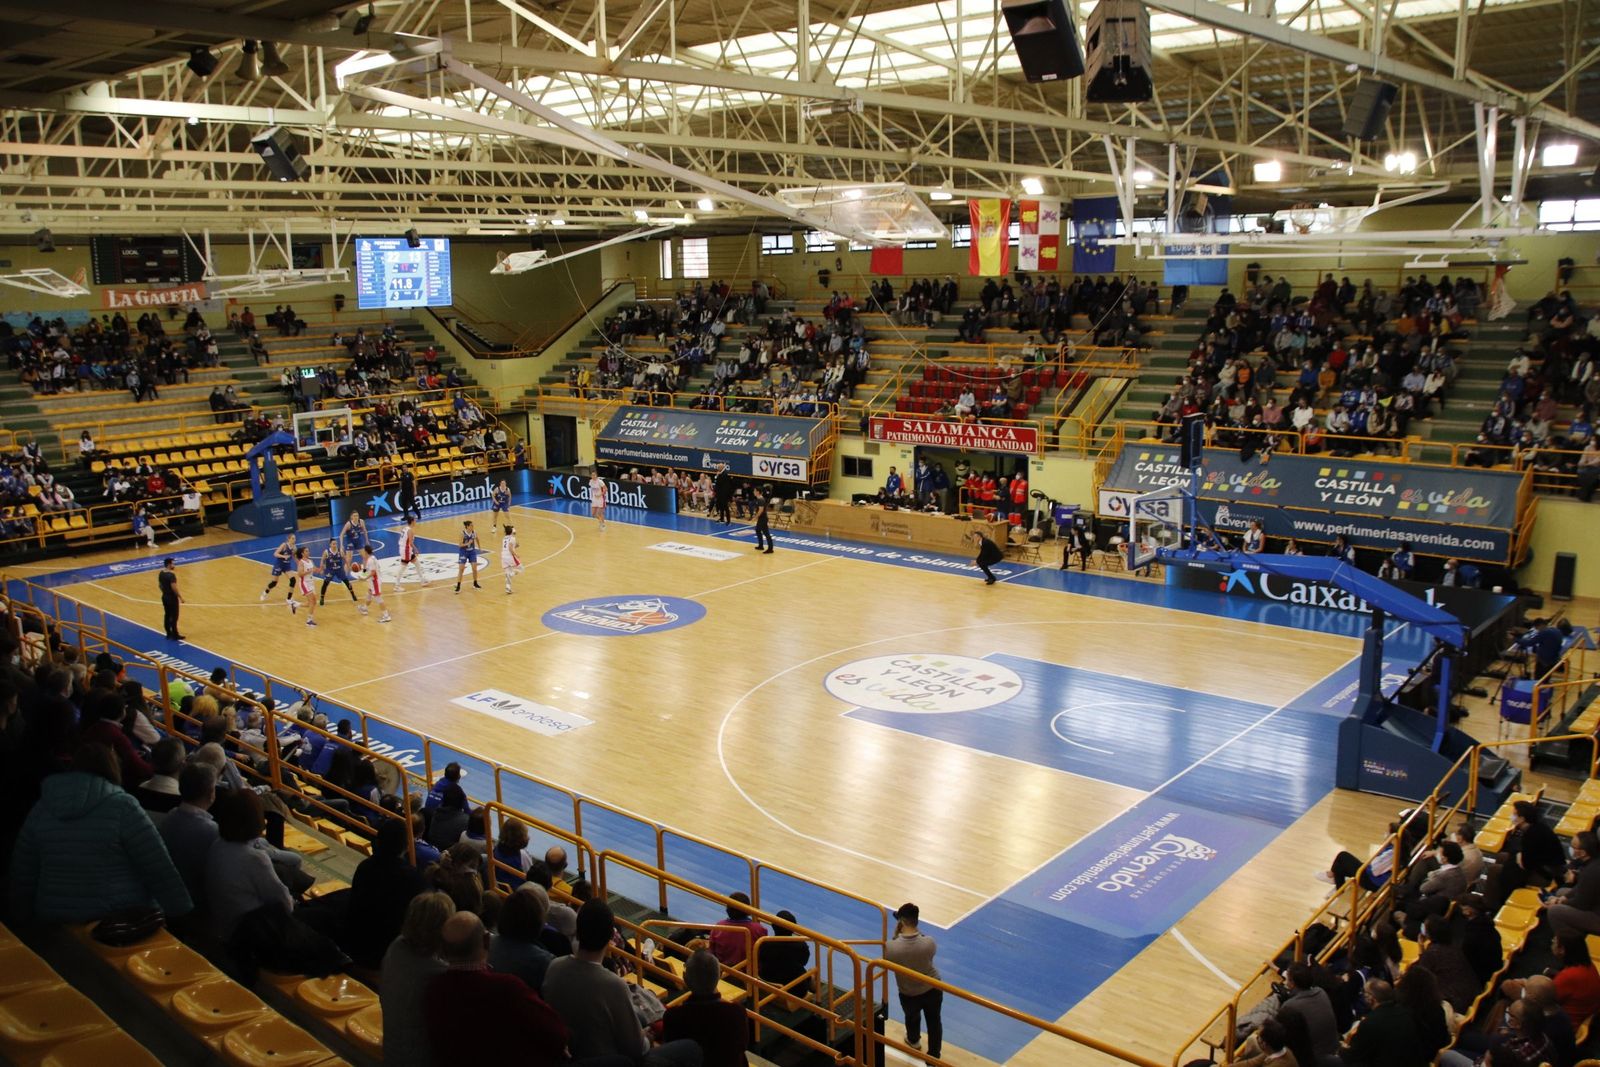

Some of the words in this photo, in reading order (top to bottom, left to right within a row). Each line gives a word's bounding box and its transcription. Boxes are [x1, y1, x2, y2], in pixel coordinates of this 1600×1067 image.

[391, 278, 413, 289] 11.8
[108, 289, 133, 308] LA
[134, 287, 201, 305] GACETA
[620, 419, 658, 428] CASTILLA
[715, 427, 759, 437] CASTILLA
[903, 421, 1017, 440] SALAMANCA
[625, 428, 649, 437] LEÓN
[886, 430, 946, 444] PATRIMONIO
[945, 435, 957, 445] DE
[960, 437, 971, 447] LA
[973, 438, 1033, 451] HUMANIDAD
[721, 437, 749, 446] LEÓN
[600, 446, 688, 463] www.perfumeriasavenida.com
[1138, 474, 1149, 483] Y
[1149, 475, 1191, 488] LEÓN
[1229, 470, 1282, 490] vida
[1314, 478, 1396, 495] CASTILLA
[1428, 487, 1491, 509] vida
[1320, 492, 1332, 503] Y
[1333, 492, 1383, 508] LEÓN
[1293, 518, 1495, 551] www.perfumeriasavenida.com
[875, 551, 902, 559] de
[560, 610, 646, 632] AVENIDA
[880, 668, 900, 676] Y
[897, 675, 966, 699] LEÓN
[890, 659, 998, 696] CASTILLA
[466, 693, 497, 703] LF
